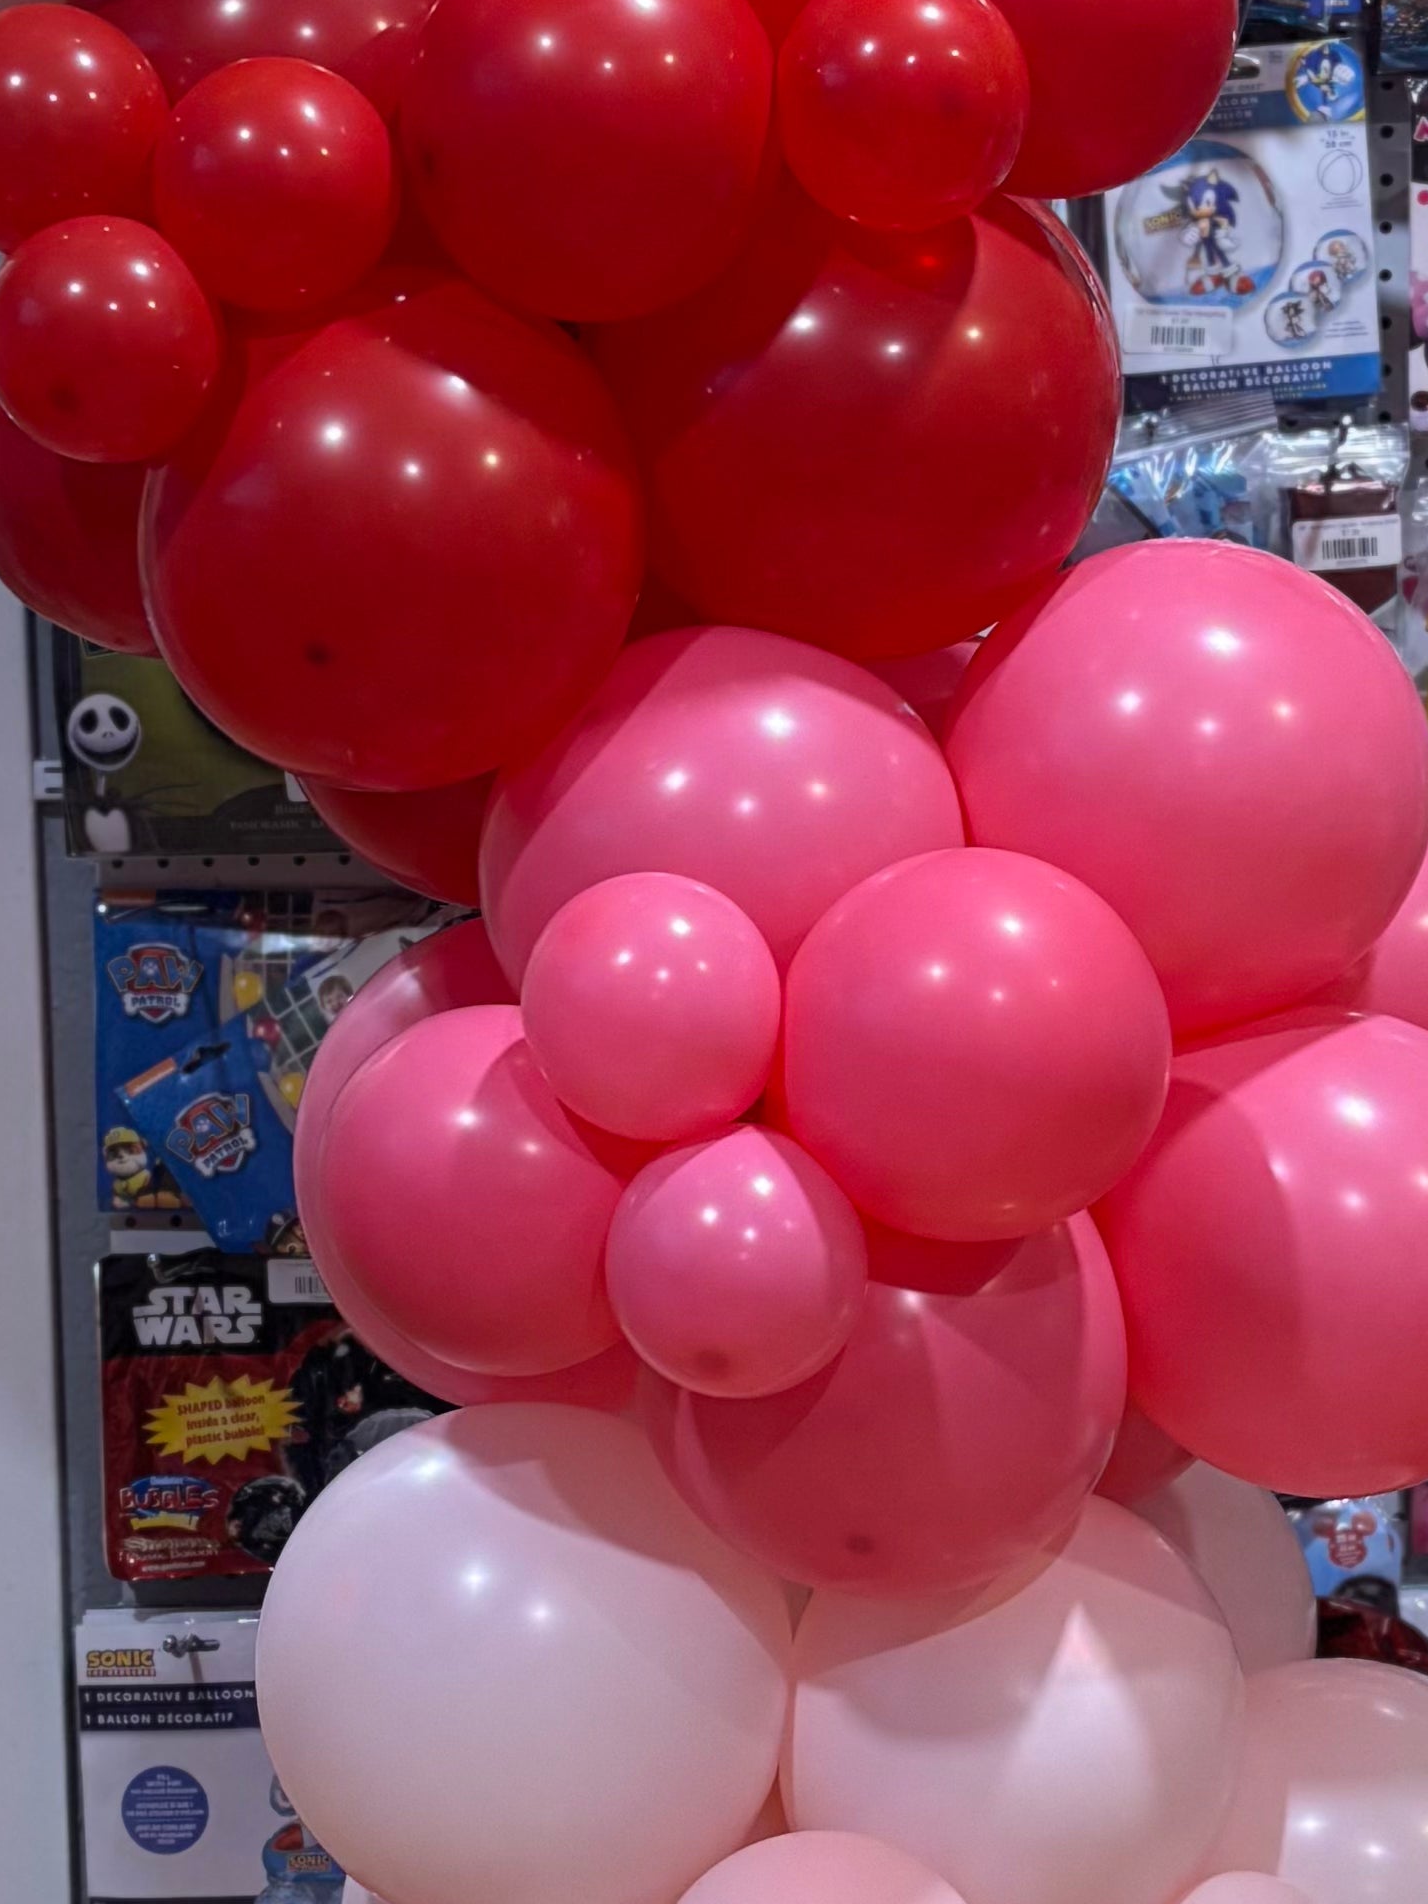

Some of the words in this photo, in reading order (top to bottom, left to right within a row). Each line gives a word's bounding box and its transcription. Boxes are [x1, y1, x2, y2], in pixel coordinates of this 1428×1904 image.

[1172, 366, 1259, 384] DECORATIVE
[1267, 360, 1333, 376] BALLOON
[1182, 378, 1240, 393] BALLON
[1245, 370, 1323, 387] DÉCORATIF
[107, 950, 204, 994] PAW
[130, 993, 182, 1009] PATROL
[166, 1093, 251, 1162] PAW
[202, 1137, 248, 1169] PATROL
[132, 1286, 262, 1316] STAR
[133, 1315, 262, 1346] WARS
[177, 1399, 222, 1416] SHAPED
[186, 1431, 222, 1448] plastic
[119, 1485, 219, 1510] BUBBLES
[87, 1649, 155, 1669] SONIC
[96, 1691, 183, 1704] DECORATIVE
[188, 1688, 254, 1702] BALLOON
[98, 1714, 151, 1726] BALLON
[157, 1711, 233, 1724] DÉCORATIF
